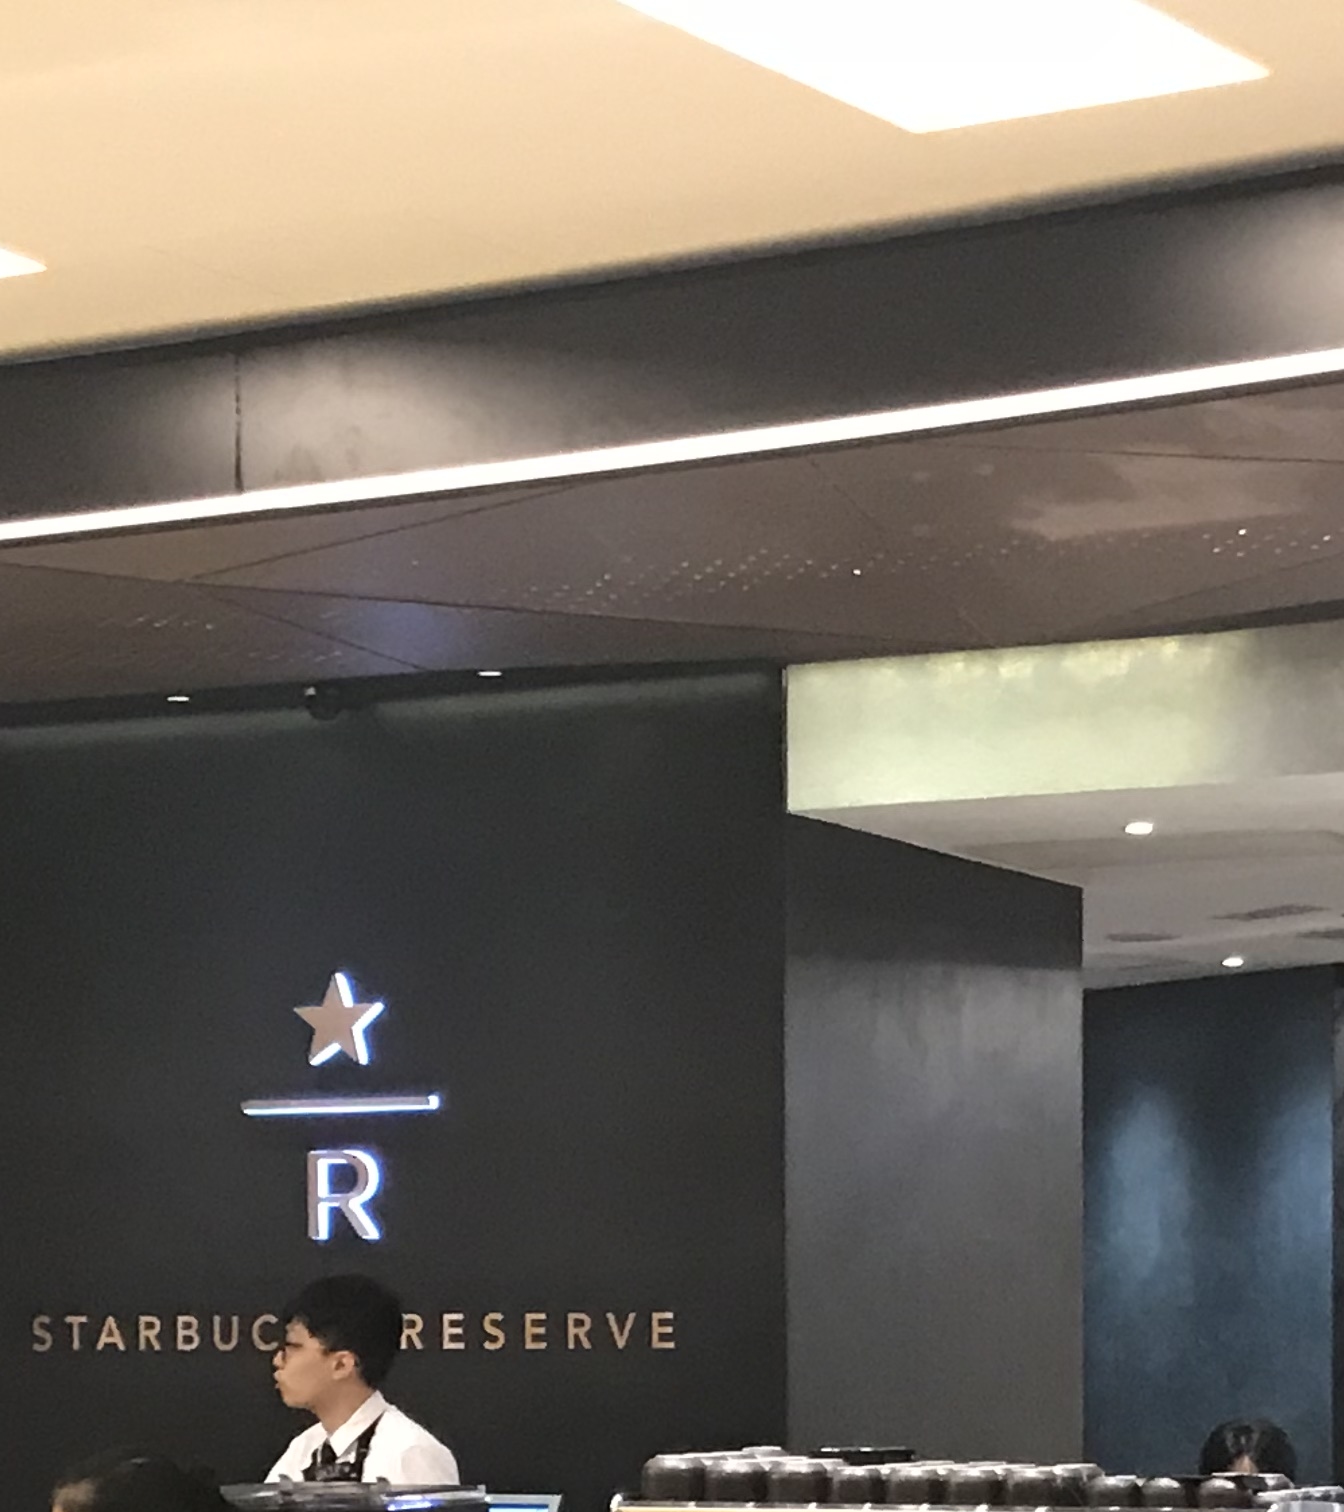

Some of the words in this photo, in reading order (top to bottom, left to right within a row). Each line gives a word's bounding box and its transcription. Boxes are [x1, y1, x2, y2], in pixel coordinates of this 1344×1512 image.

[306, 1148, 383, 1241] R
[32, 1313, 280, 1352] STARBUC
[399, 1310, 677, 1351] RESERVE
